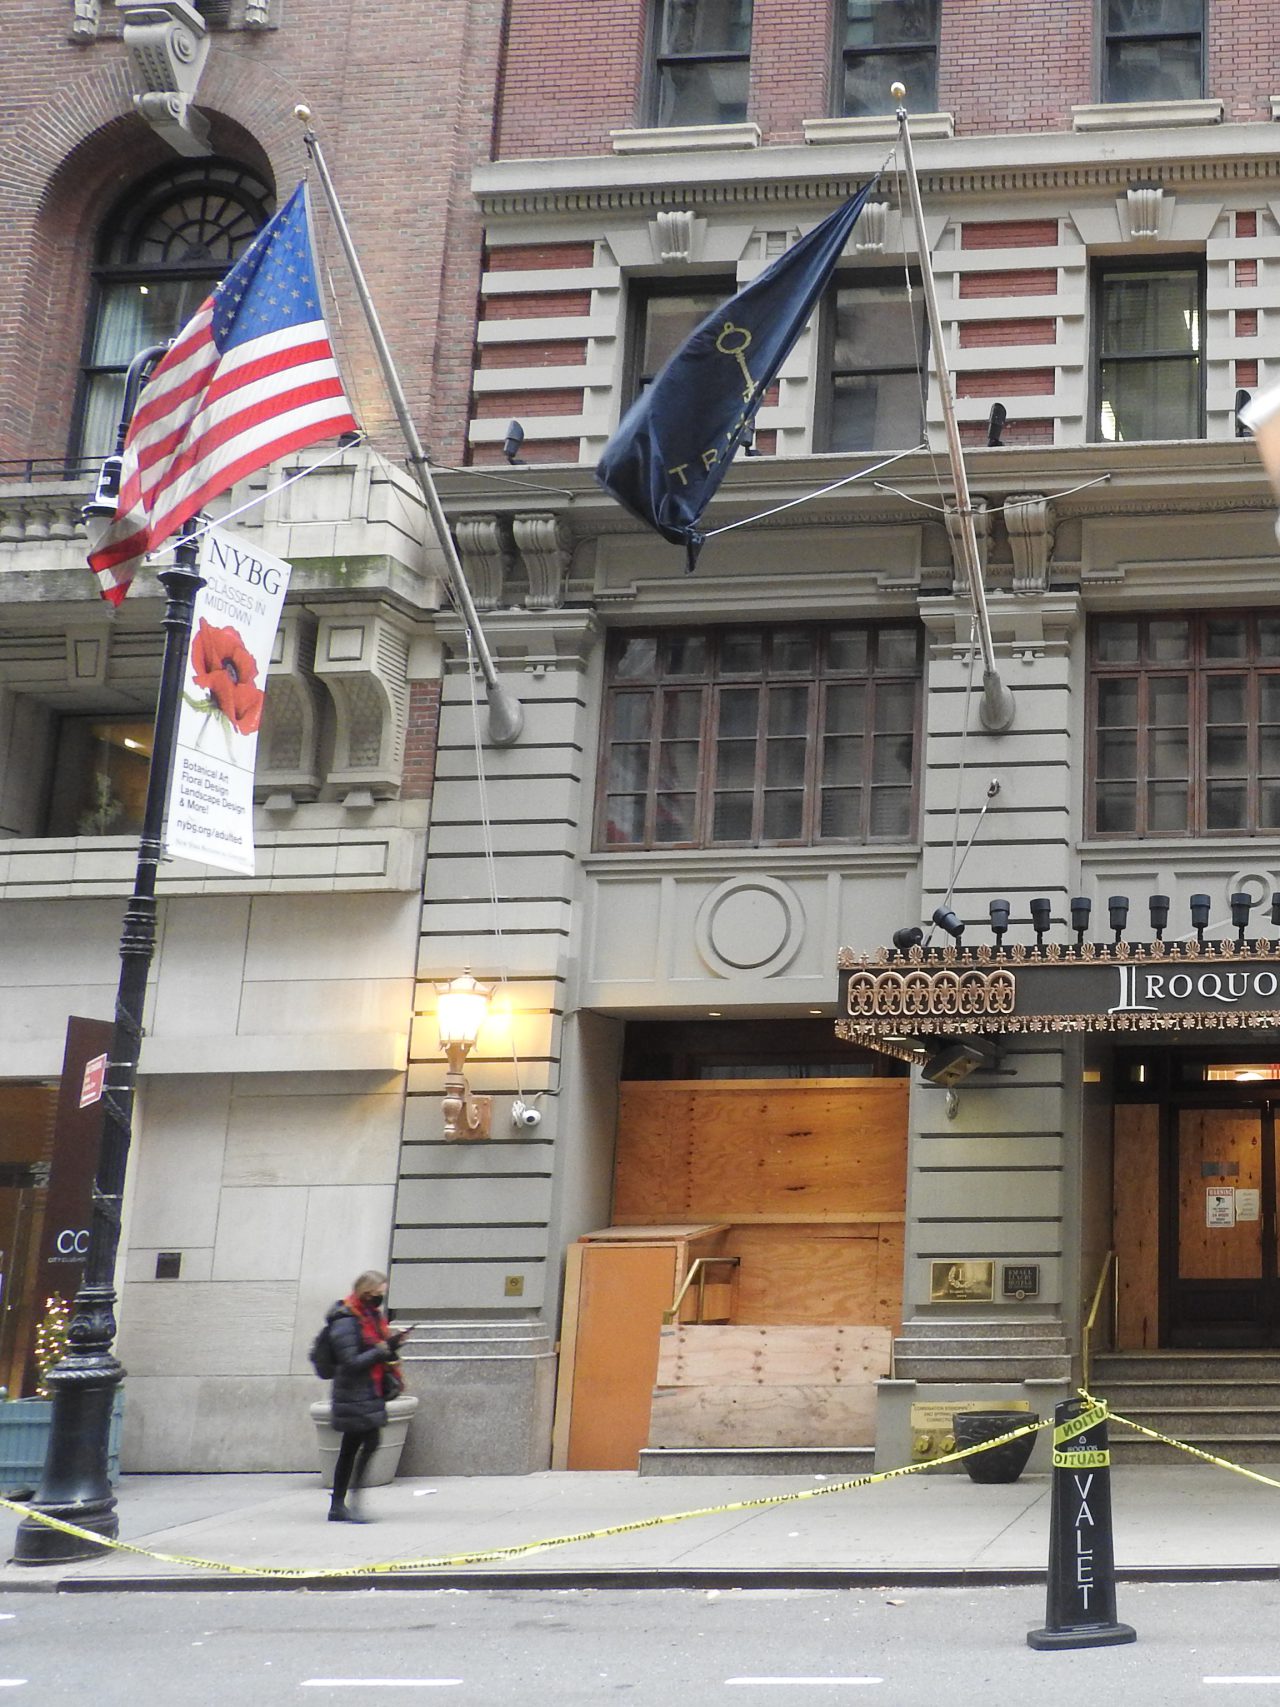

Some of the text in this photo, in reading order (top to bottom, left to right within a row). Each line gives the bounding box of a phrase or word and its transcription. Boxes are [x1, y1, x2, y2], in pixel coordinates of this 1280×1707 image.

[208, 537, 281, 595] NYBG
[205, 592, 252, 626] MIDTOWN
[206, 576, 266, 616] CLASSES IN
[182, 771, 229, 796] Floral Design
[183, 758, 229, 784] Botanical Art
[179, 798, 209, 815] & More!
[180, 784, 246, 815] Landscape Design
[811, 1476, 873, 1496] CAUTION
[1074, 1473, 1096, 1611] VALET
